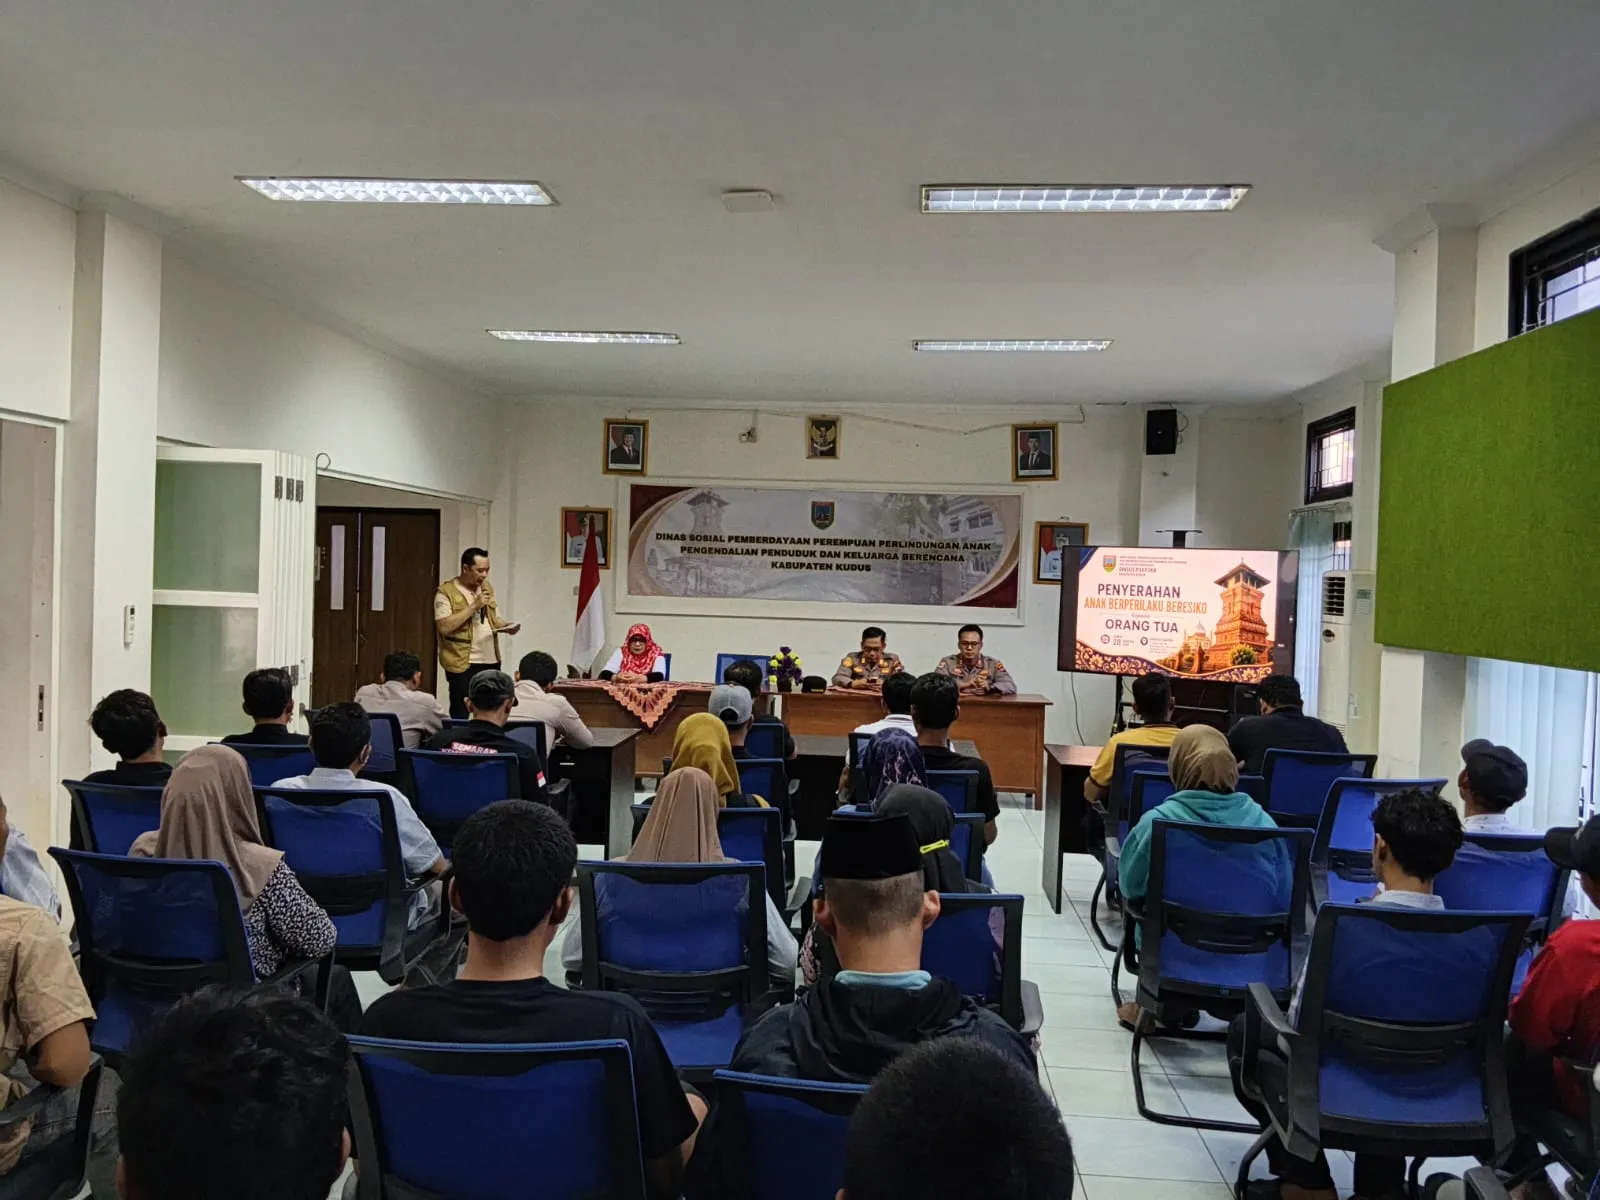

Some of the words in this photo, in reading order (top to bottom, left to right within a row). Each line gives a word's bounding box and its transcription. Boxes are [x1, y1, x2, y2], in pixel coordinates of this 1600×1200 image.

[656, 532, 686, 541] DINAS
[689, 534, 725, 543] SOSIAL
[728, 535, 810, 546] PEMBERDAYAAN
[813, 537, 876, 548] PEREMPUAN
[879, 540, 960, 549] PERLINDUNGAN
[963, 542, 992, 550] ANAK
[680, 546, 758, 556] PENGENDALIAN
[761, 548, 817, 558] PENDUDUK
[843, 551, 899, 561] KELUARGA
[902, 553, 965, 562] BERENCANA
[771, 561, 833, 570] KABUPATEN
[835, 563, 872, 572] KUDUS
[1098, 583, 1181, 598] PENYERAHAN
[1084, 596, 1107, 609] ANAK
[1109, 598, 1164, 612] BERPERILAKU
[1166, 601, 1208, 614] BERESIKO
[1105, 619, 1150, 631] ORANG
[1153, 621, 1178, 633] TUA
